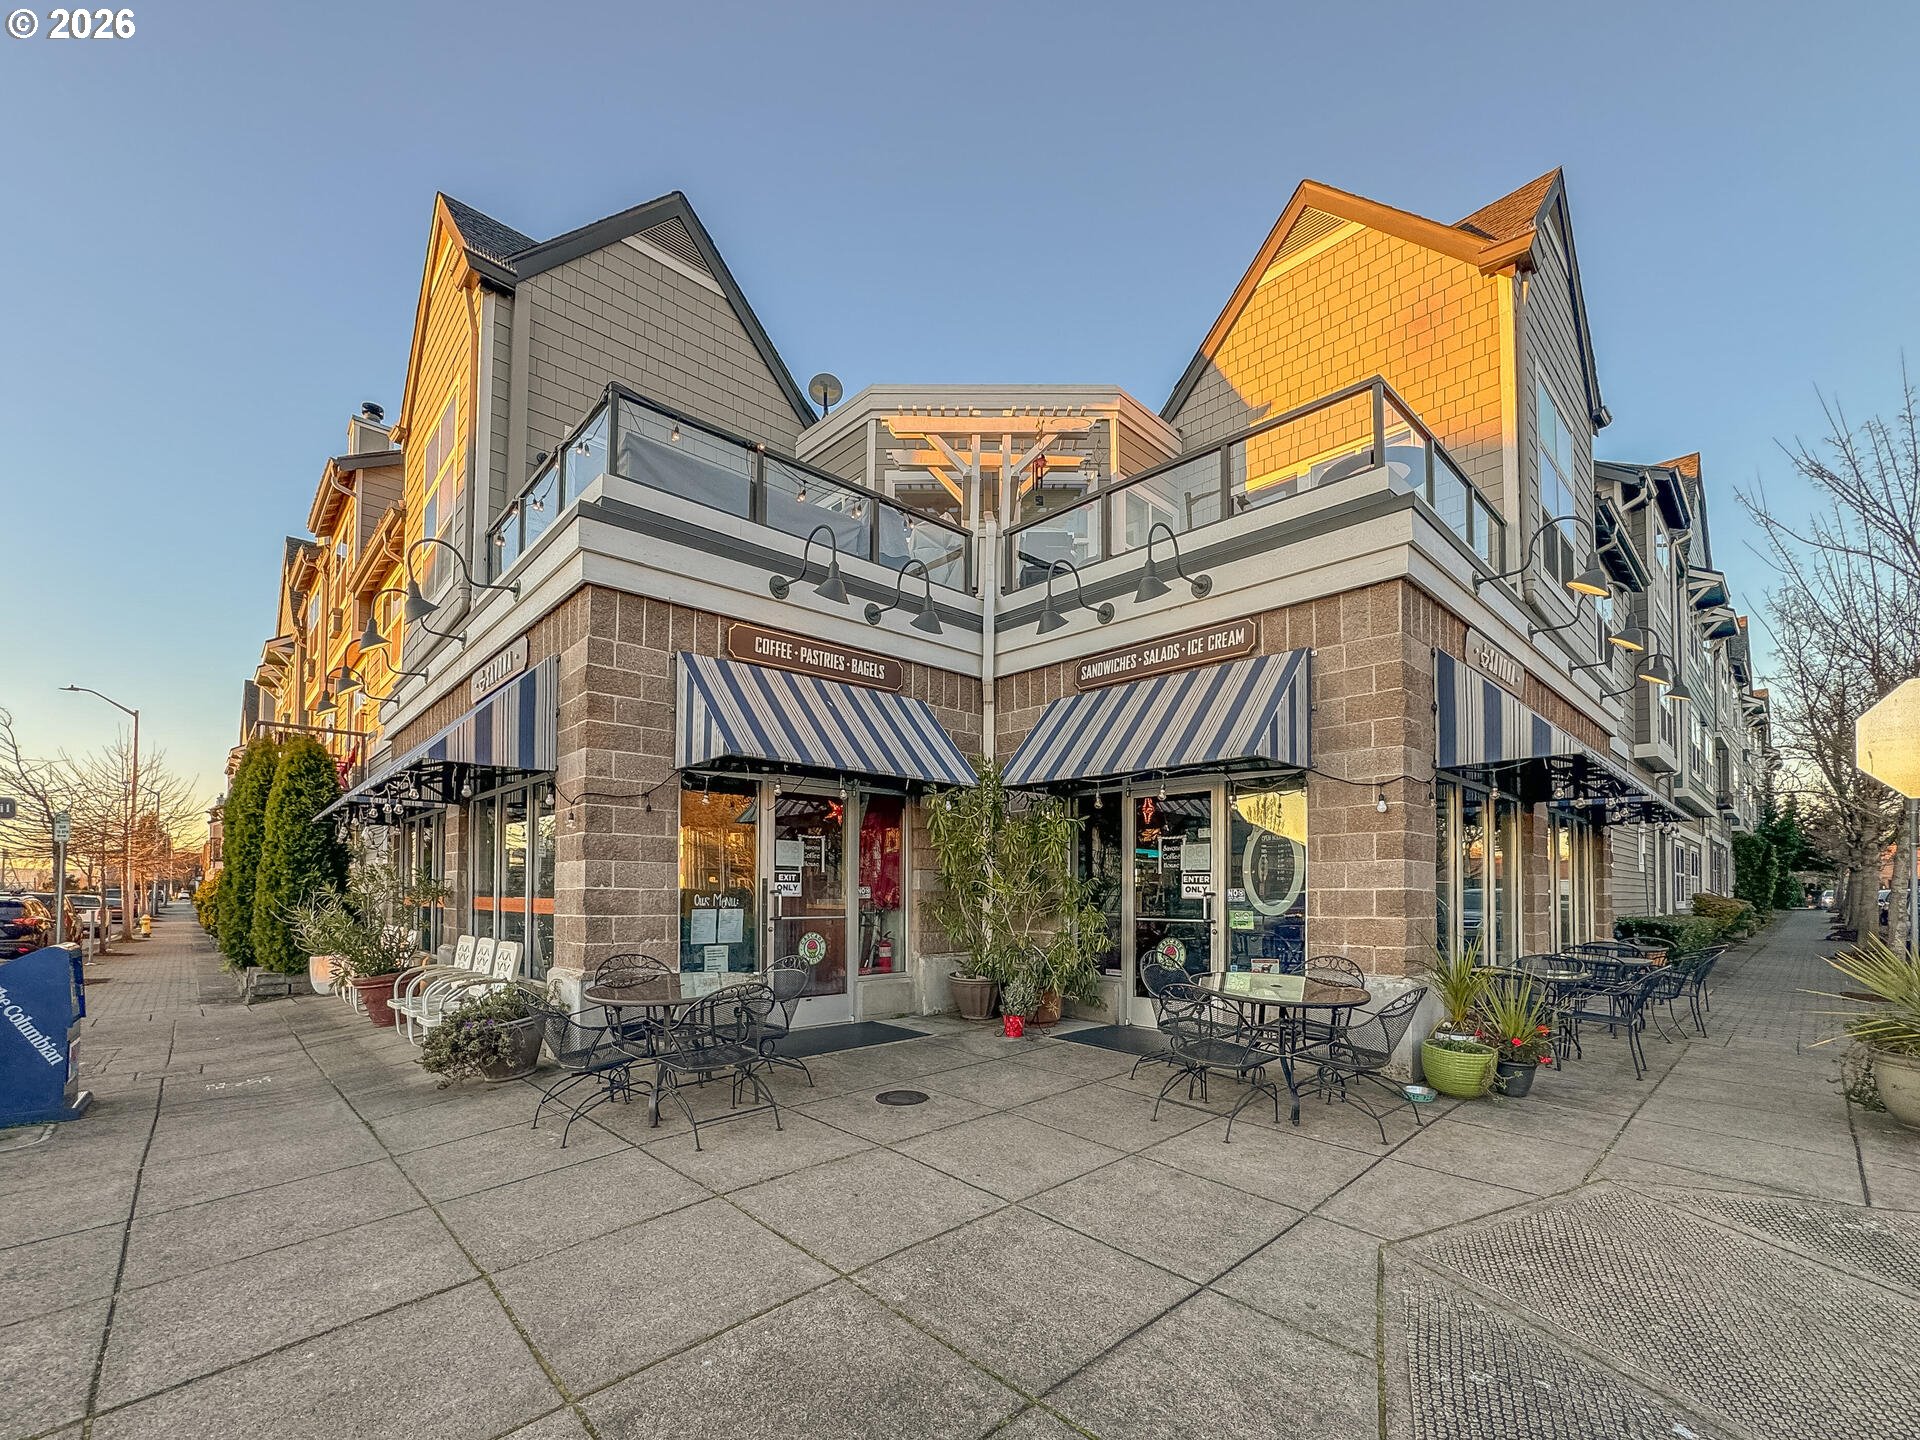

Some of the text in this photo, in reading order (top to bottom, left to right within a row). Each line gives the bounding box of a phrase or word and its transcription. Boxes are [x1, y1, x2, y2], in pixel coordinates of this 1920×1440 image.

[754, 636, 885, 680] COFFEE PASTRIES BAGELS
[1080, 627, 1245, 681] SANDWICHES SALADS ICE CREAM
[778, 874, 797, 882] EXIT
[3, 1005, 64, 1066] Columbian
